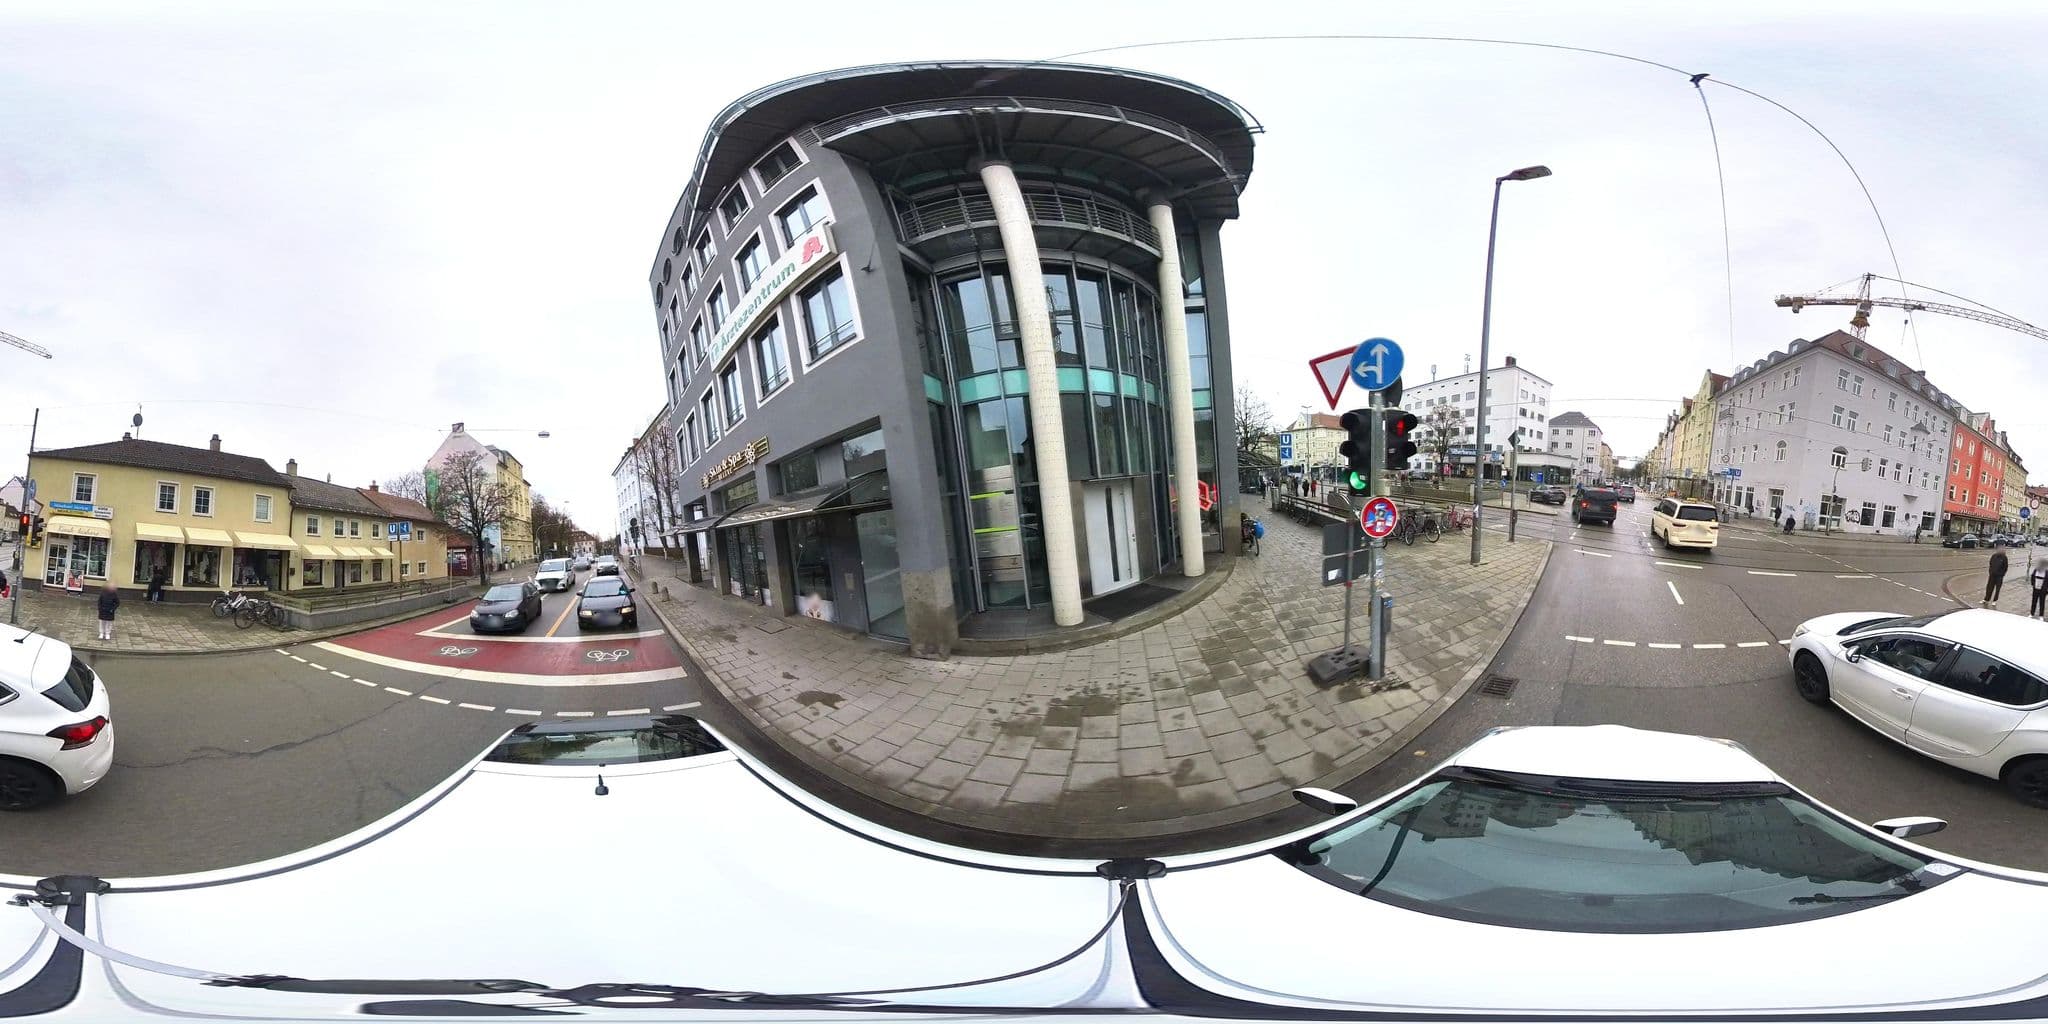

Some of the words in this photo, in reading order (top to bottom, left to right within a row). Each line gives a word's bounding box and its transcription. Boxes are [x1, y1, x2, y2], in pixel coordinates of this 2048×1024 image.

[720, 261, 796, 352] Ärztezentrum
[1282, 435, 1290, 444] U
[710, 465, 722, 478] Skin
[721, 459, 727, 470] &
[728, 452, 742, 468] Spa
[390, 524, 395, 532] U
